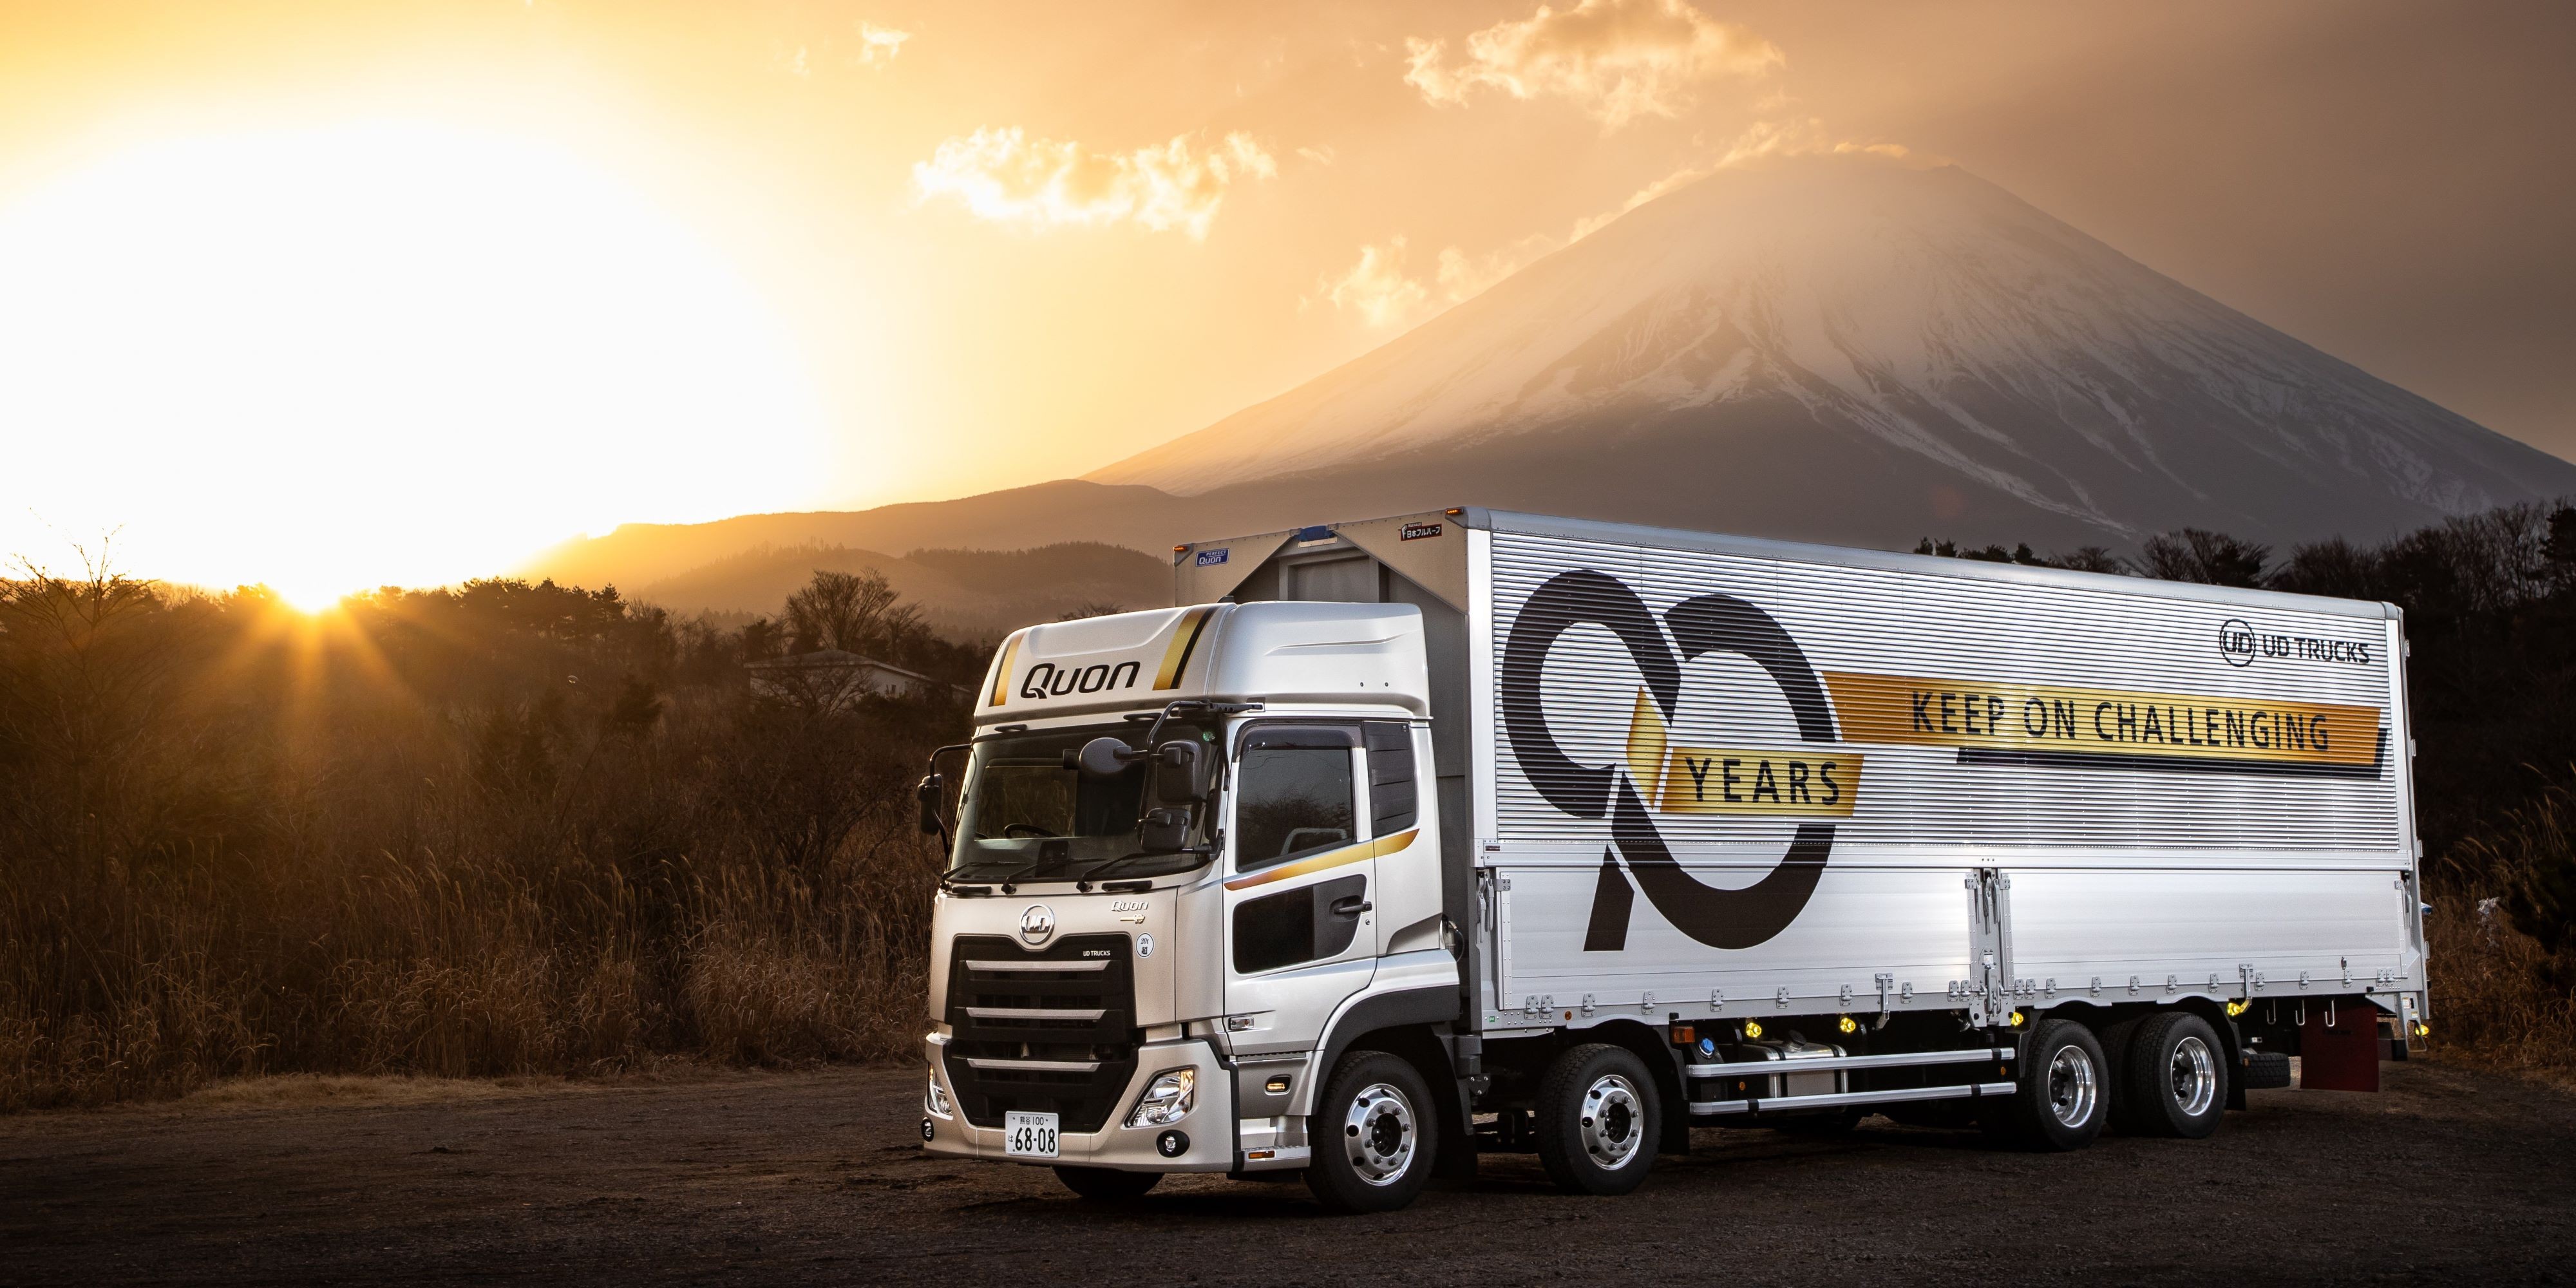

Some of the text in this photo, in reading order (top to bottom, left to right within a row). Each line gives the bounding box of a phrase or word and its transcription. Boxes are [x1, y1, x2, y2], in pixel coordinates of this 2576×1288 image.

[1406, 526, 1441, 538] 日本フルハーフ
[1199, 556, 1222, 565] Quon
[2223, 631, 2253, 654] UD
[2263, 634, 2371, 663] UD TRUCKS
[1913, 691, 2329, 752] KEEP ON CHALLENGING
[1501, 569, 1837, 952] 90
[1685, 757, 1840, 806] YEARS
[1021, 915, 1050, 934] UD
[1019, 1116, 1044, 1126] 熊谷 100
[1015, 1127, 1056, 1153] 68-08
